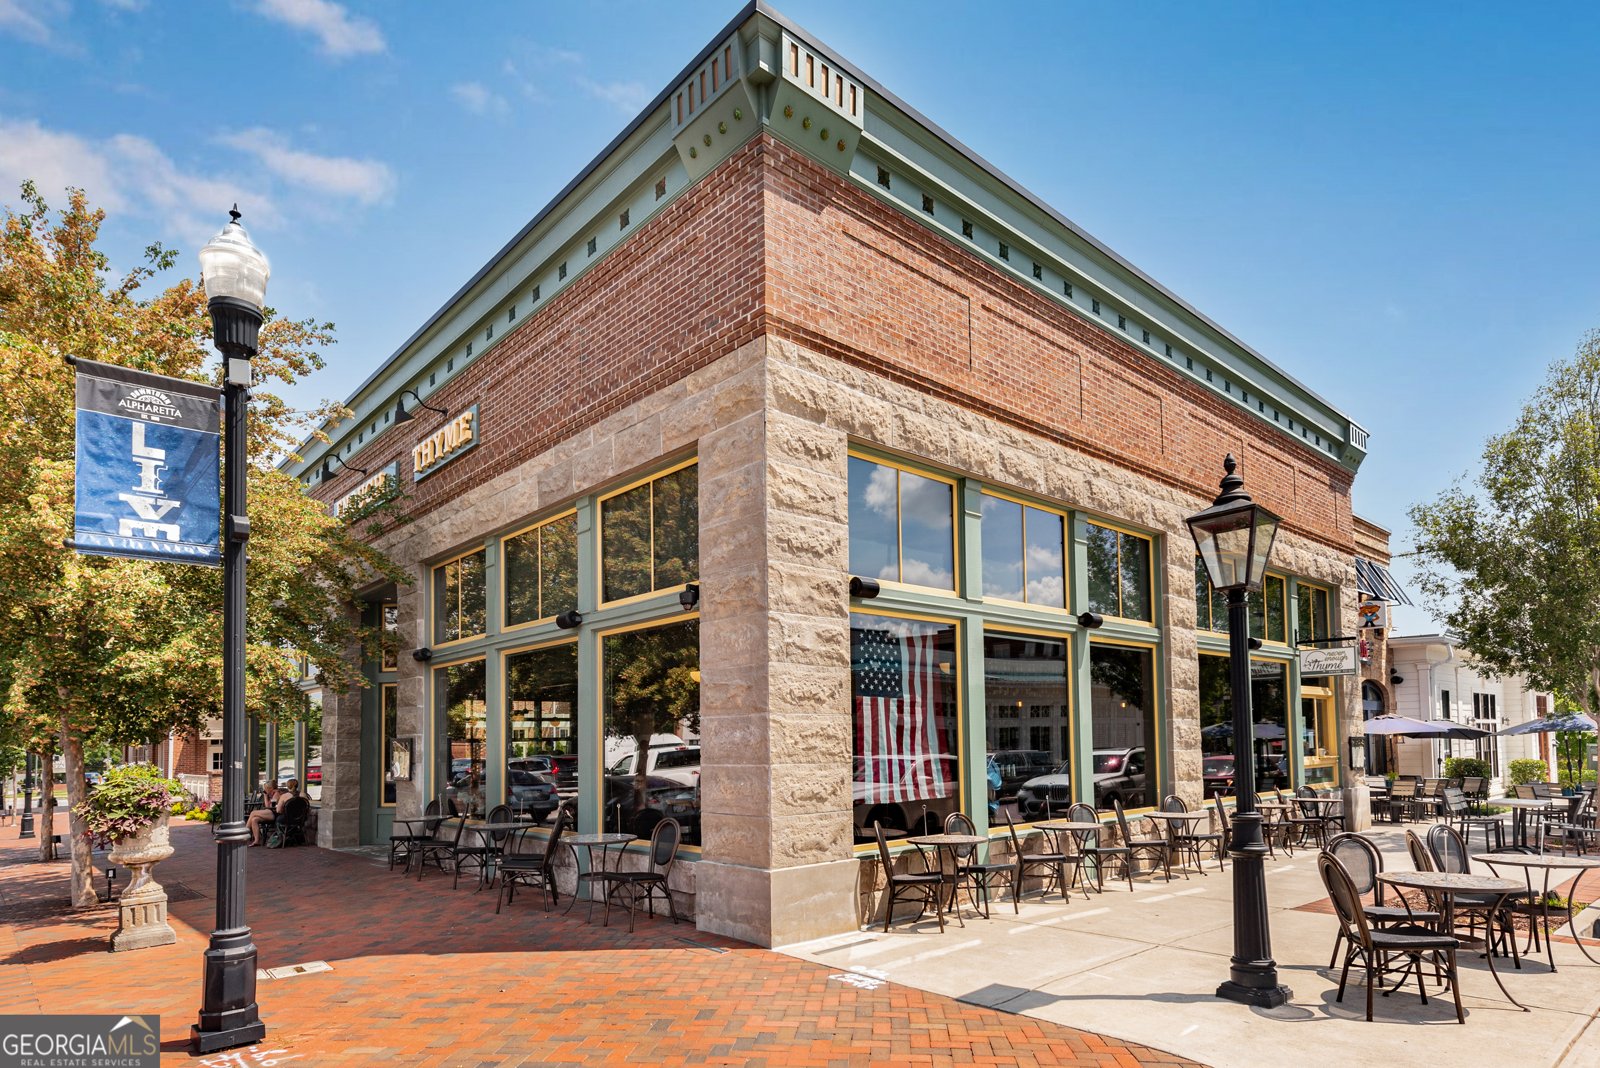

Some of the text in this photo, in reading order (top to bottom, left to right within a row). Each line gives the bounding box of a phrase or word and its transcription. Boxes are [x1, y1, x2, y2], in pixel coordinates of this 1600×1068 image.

[130, 388, 172, 405] DOWNTOWN
[118, 398, 183, 418] ALPHARETTA
[412, 411, 474, 473] THYME
[1311, 659, 1344, 671] Thyme
